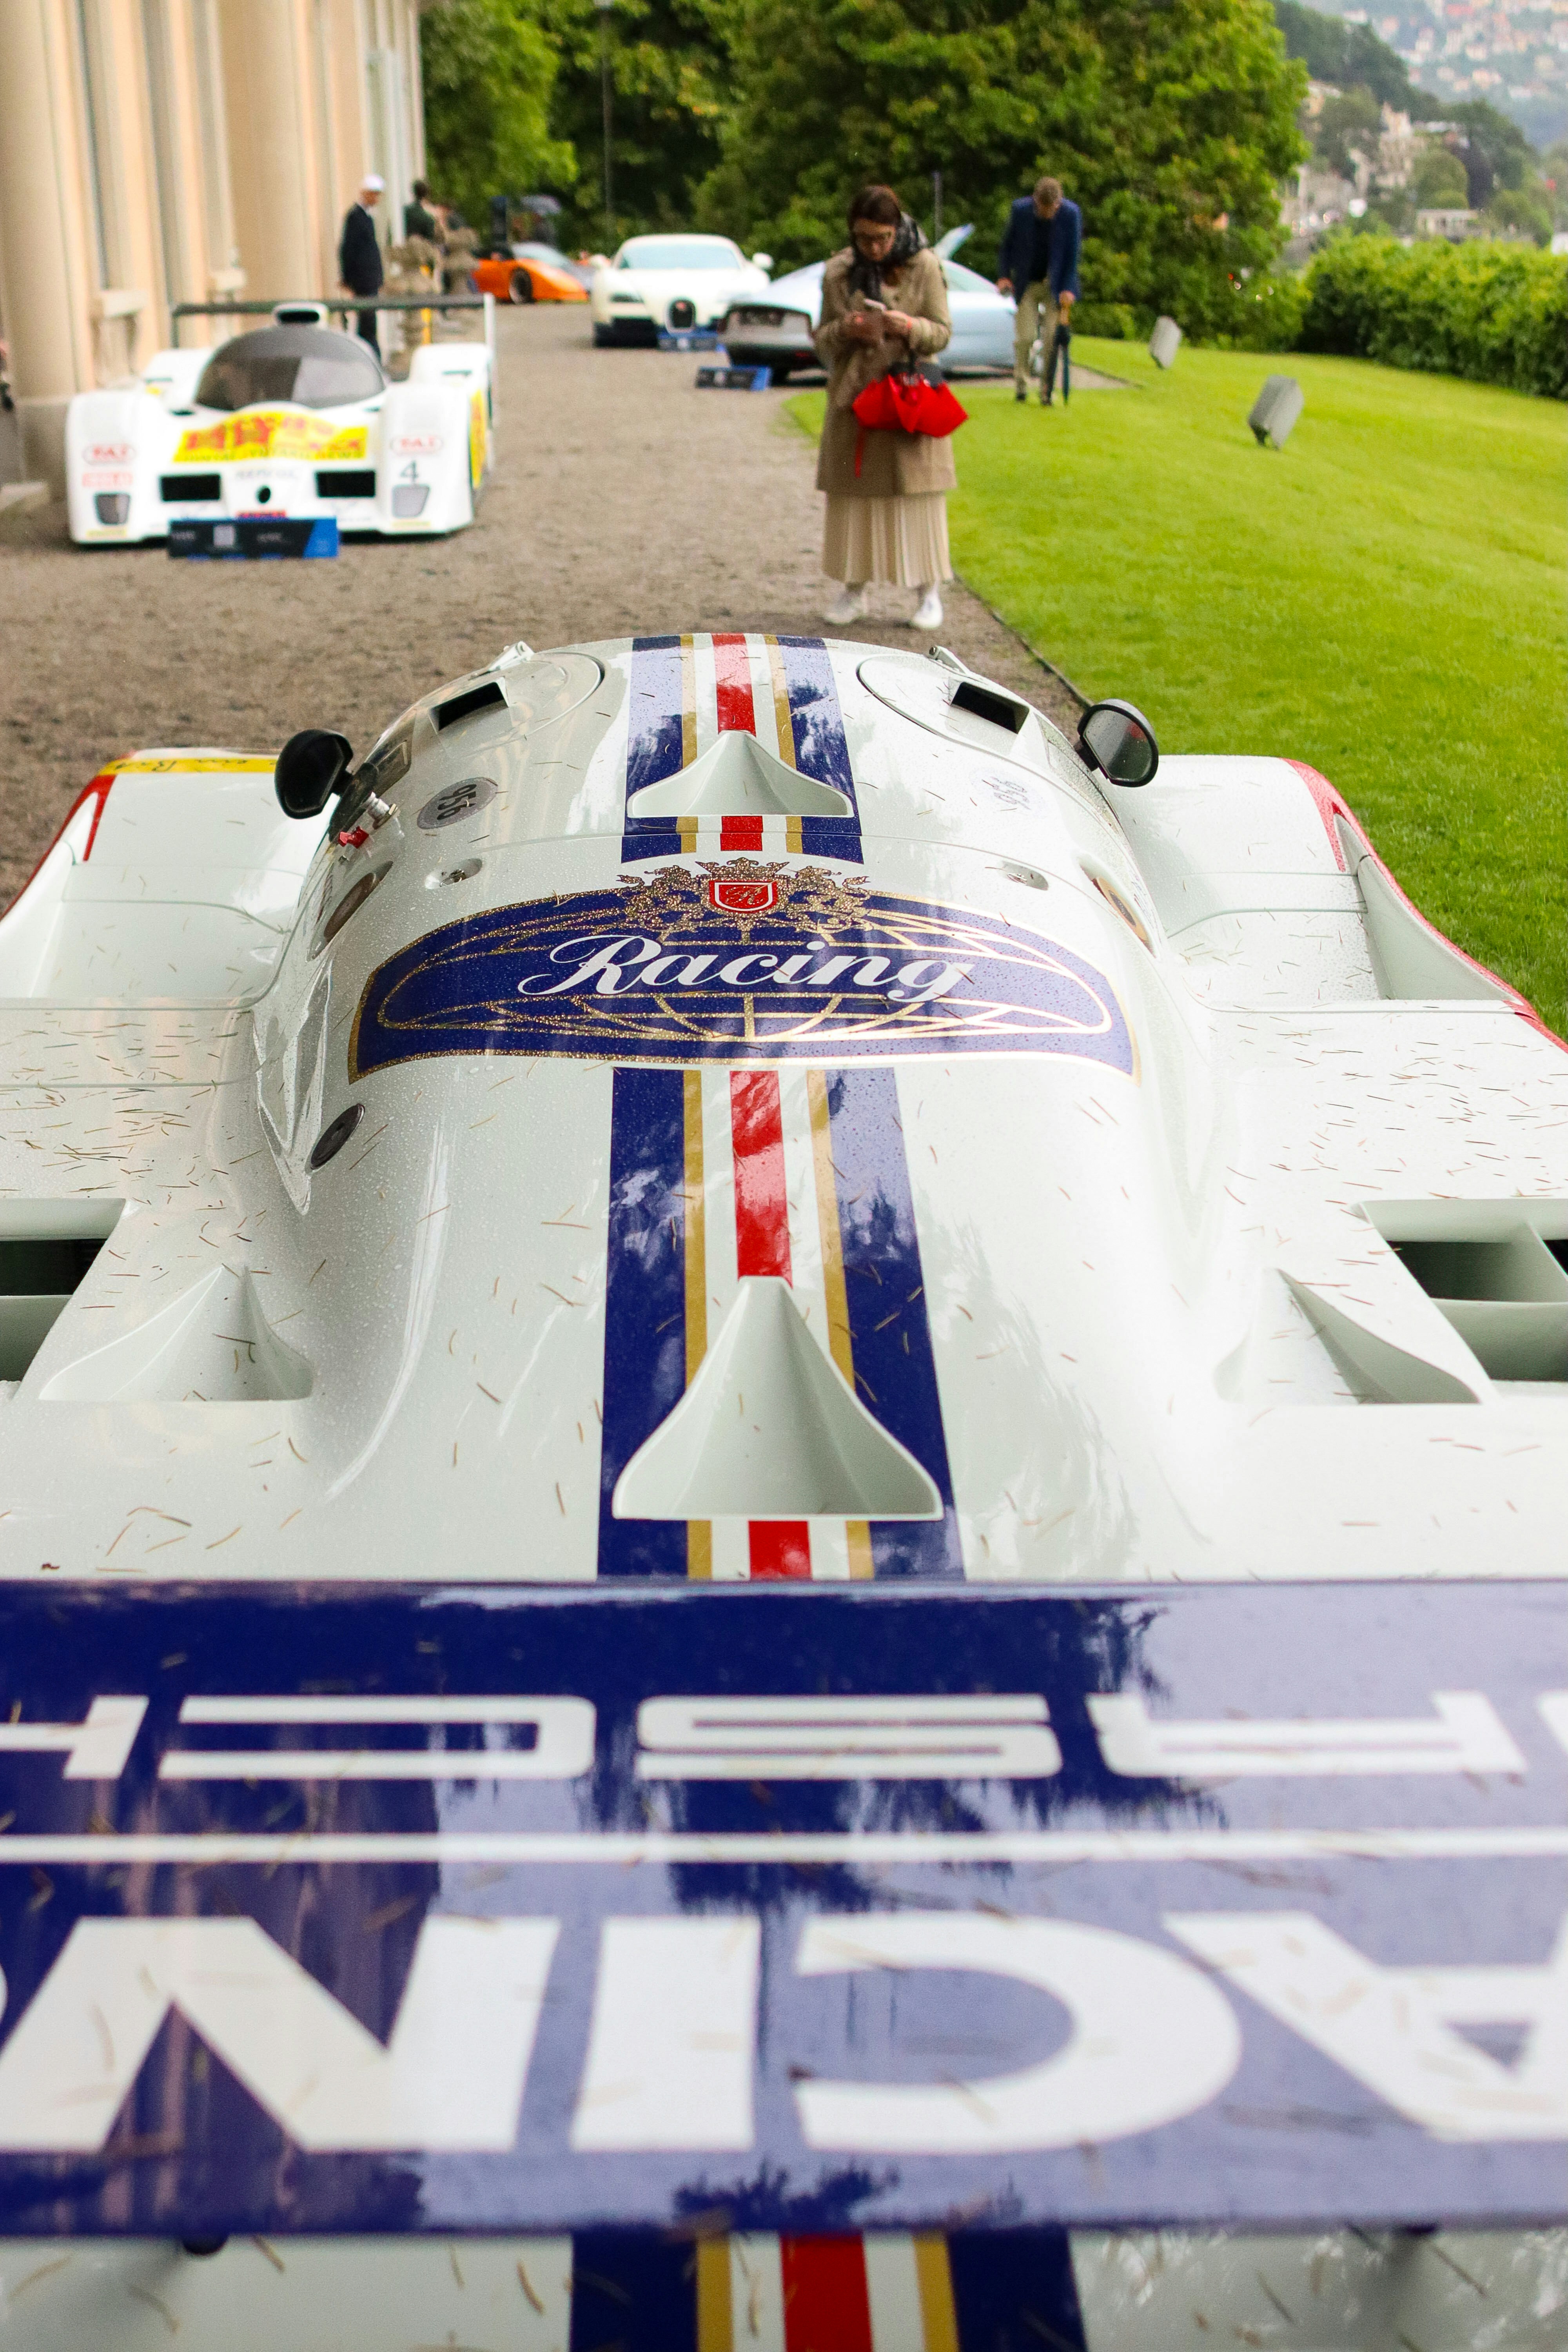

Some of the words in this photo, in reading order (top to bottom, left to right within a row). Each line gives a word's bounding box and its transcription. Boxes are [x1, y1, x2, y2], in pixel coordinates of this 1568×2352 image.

[400, 460, 419, 483] 4
[437, 784, 477, 820] 956
[517, 935, 975, 1003] Racing
[0, 1690, 1568, 1779] RSC
[0, 1911, 1568, 2151] ACIN
